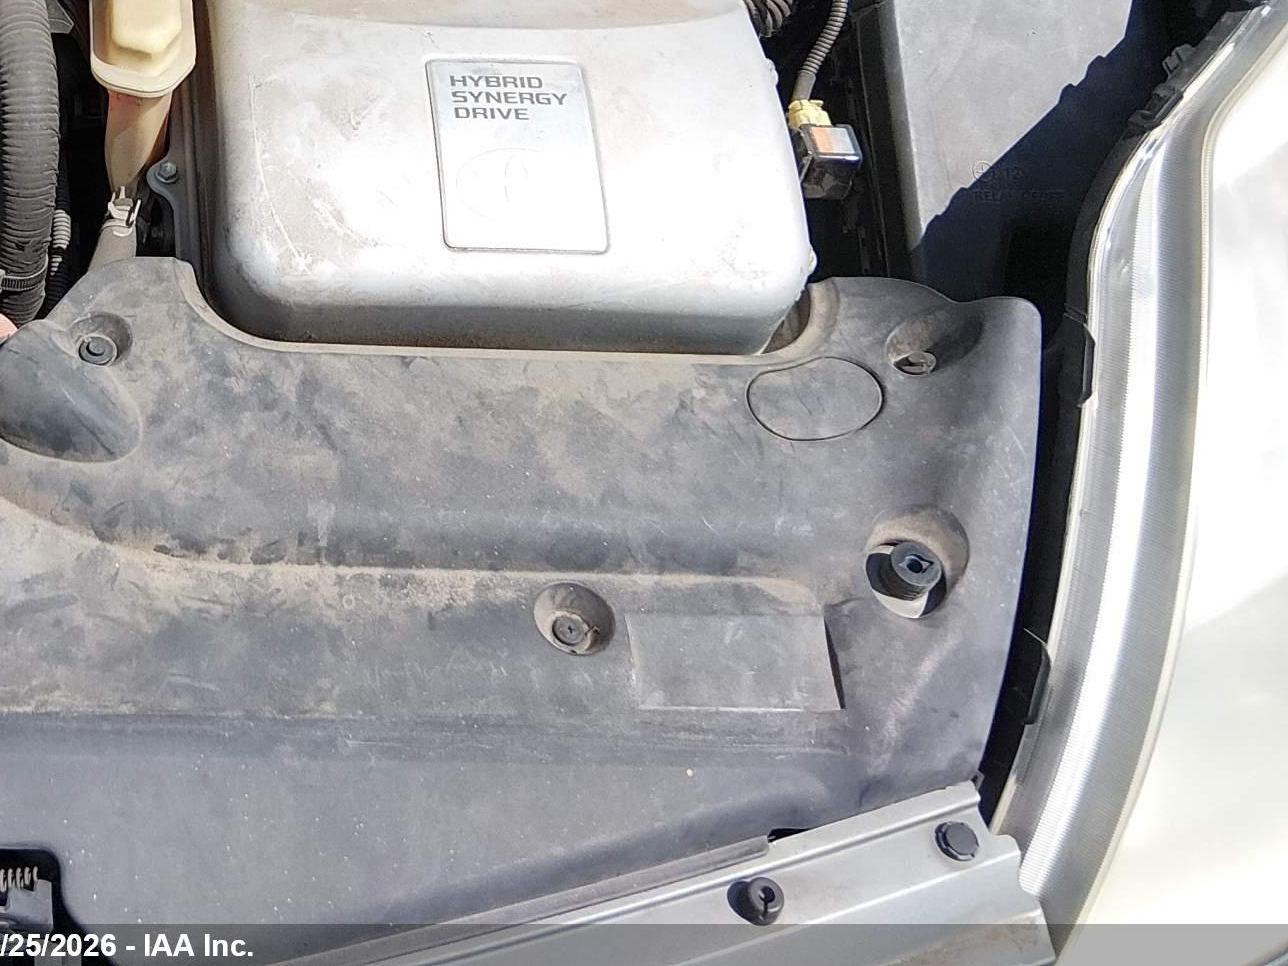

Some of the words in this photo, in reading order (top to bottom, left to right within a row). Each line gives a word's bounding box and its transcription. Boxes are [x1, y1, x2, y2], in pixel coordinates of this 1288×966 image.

[449, 75, 543, 89] HYBRID
[451, 91, 568, 106] SYNERGY
[454, 107, 530, 121] DRIVE
